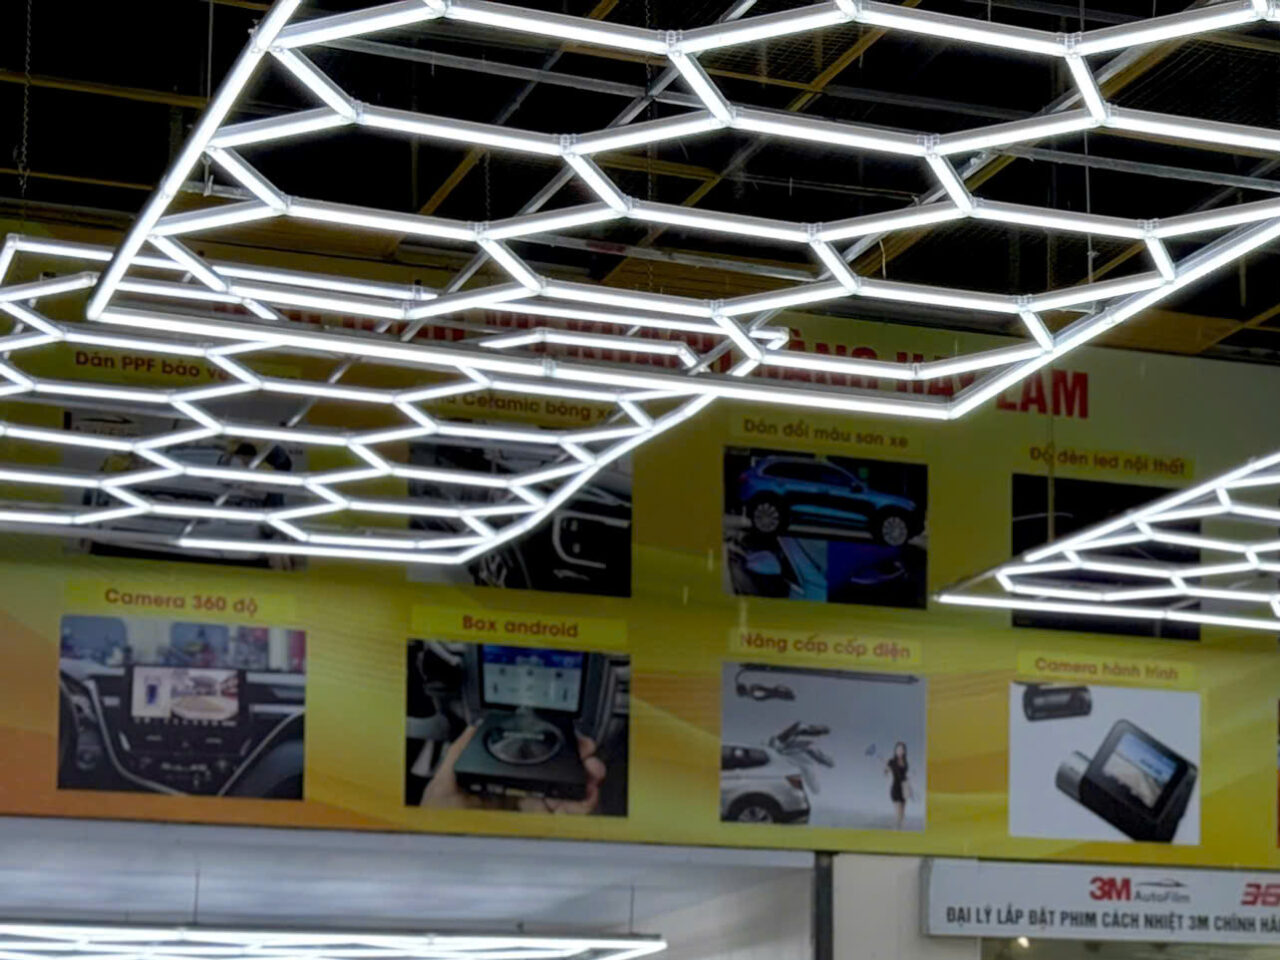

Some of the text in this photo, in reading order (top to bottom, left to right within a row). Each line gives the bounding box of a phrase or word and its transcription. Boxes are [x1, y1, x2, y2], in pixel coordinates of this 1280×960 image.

[75, 350, 115, 368] Dán
[121, 356, 155, 372] PPF
[462, 391, 540, 414] Ceramic
[1093, 454, 1119, 469] led
[104, 588, 258, 618] Camera 360 độ
[462, 614, 579, 638] Box android
[1035, 656, 1098, 675] Camera
[1089, 876, 1191, 904] 3M AutoFilm
[946, 906, 971, 928] ĐẠI
[1060, 910, 1097, 928] PHIM
[1102, 907, 1139, 929] CÁCH
[1188, 915, 1209, 931] 3M
